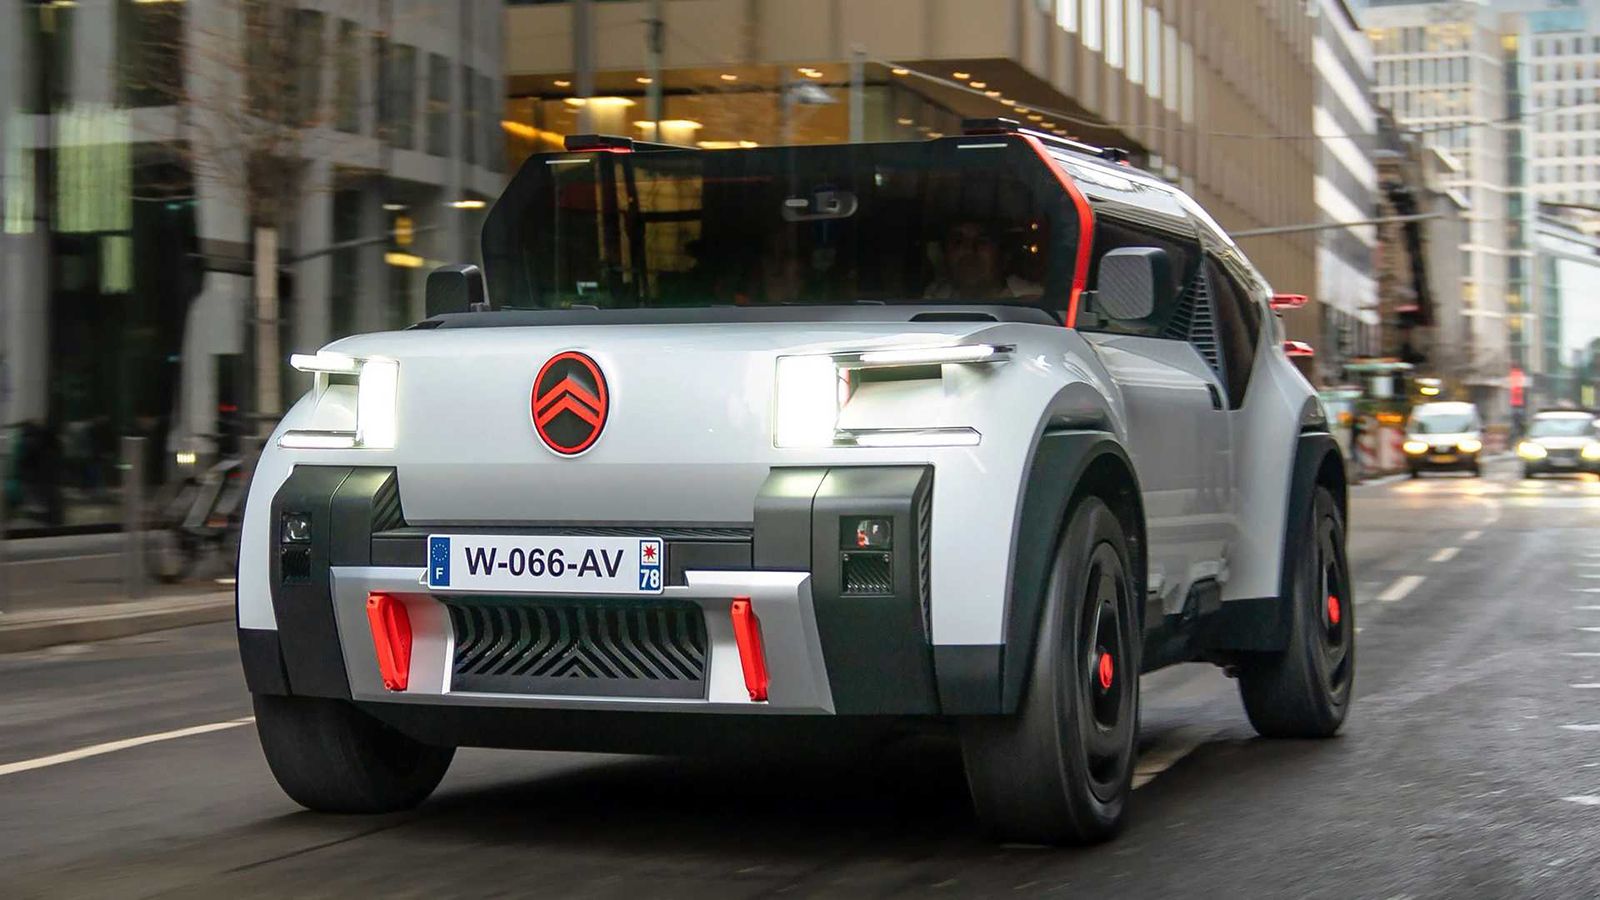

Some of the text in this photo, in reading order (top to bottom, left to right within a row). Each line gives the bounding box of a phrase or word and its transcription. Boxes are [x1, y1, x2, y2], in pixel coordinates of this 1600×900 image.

[465, 547, 624, 578] W-066-AV
[435, 567, 443, 580] F
[640, 569, 660, 588] 78
